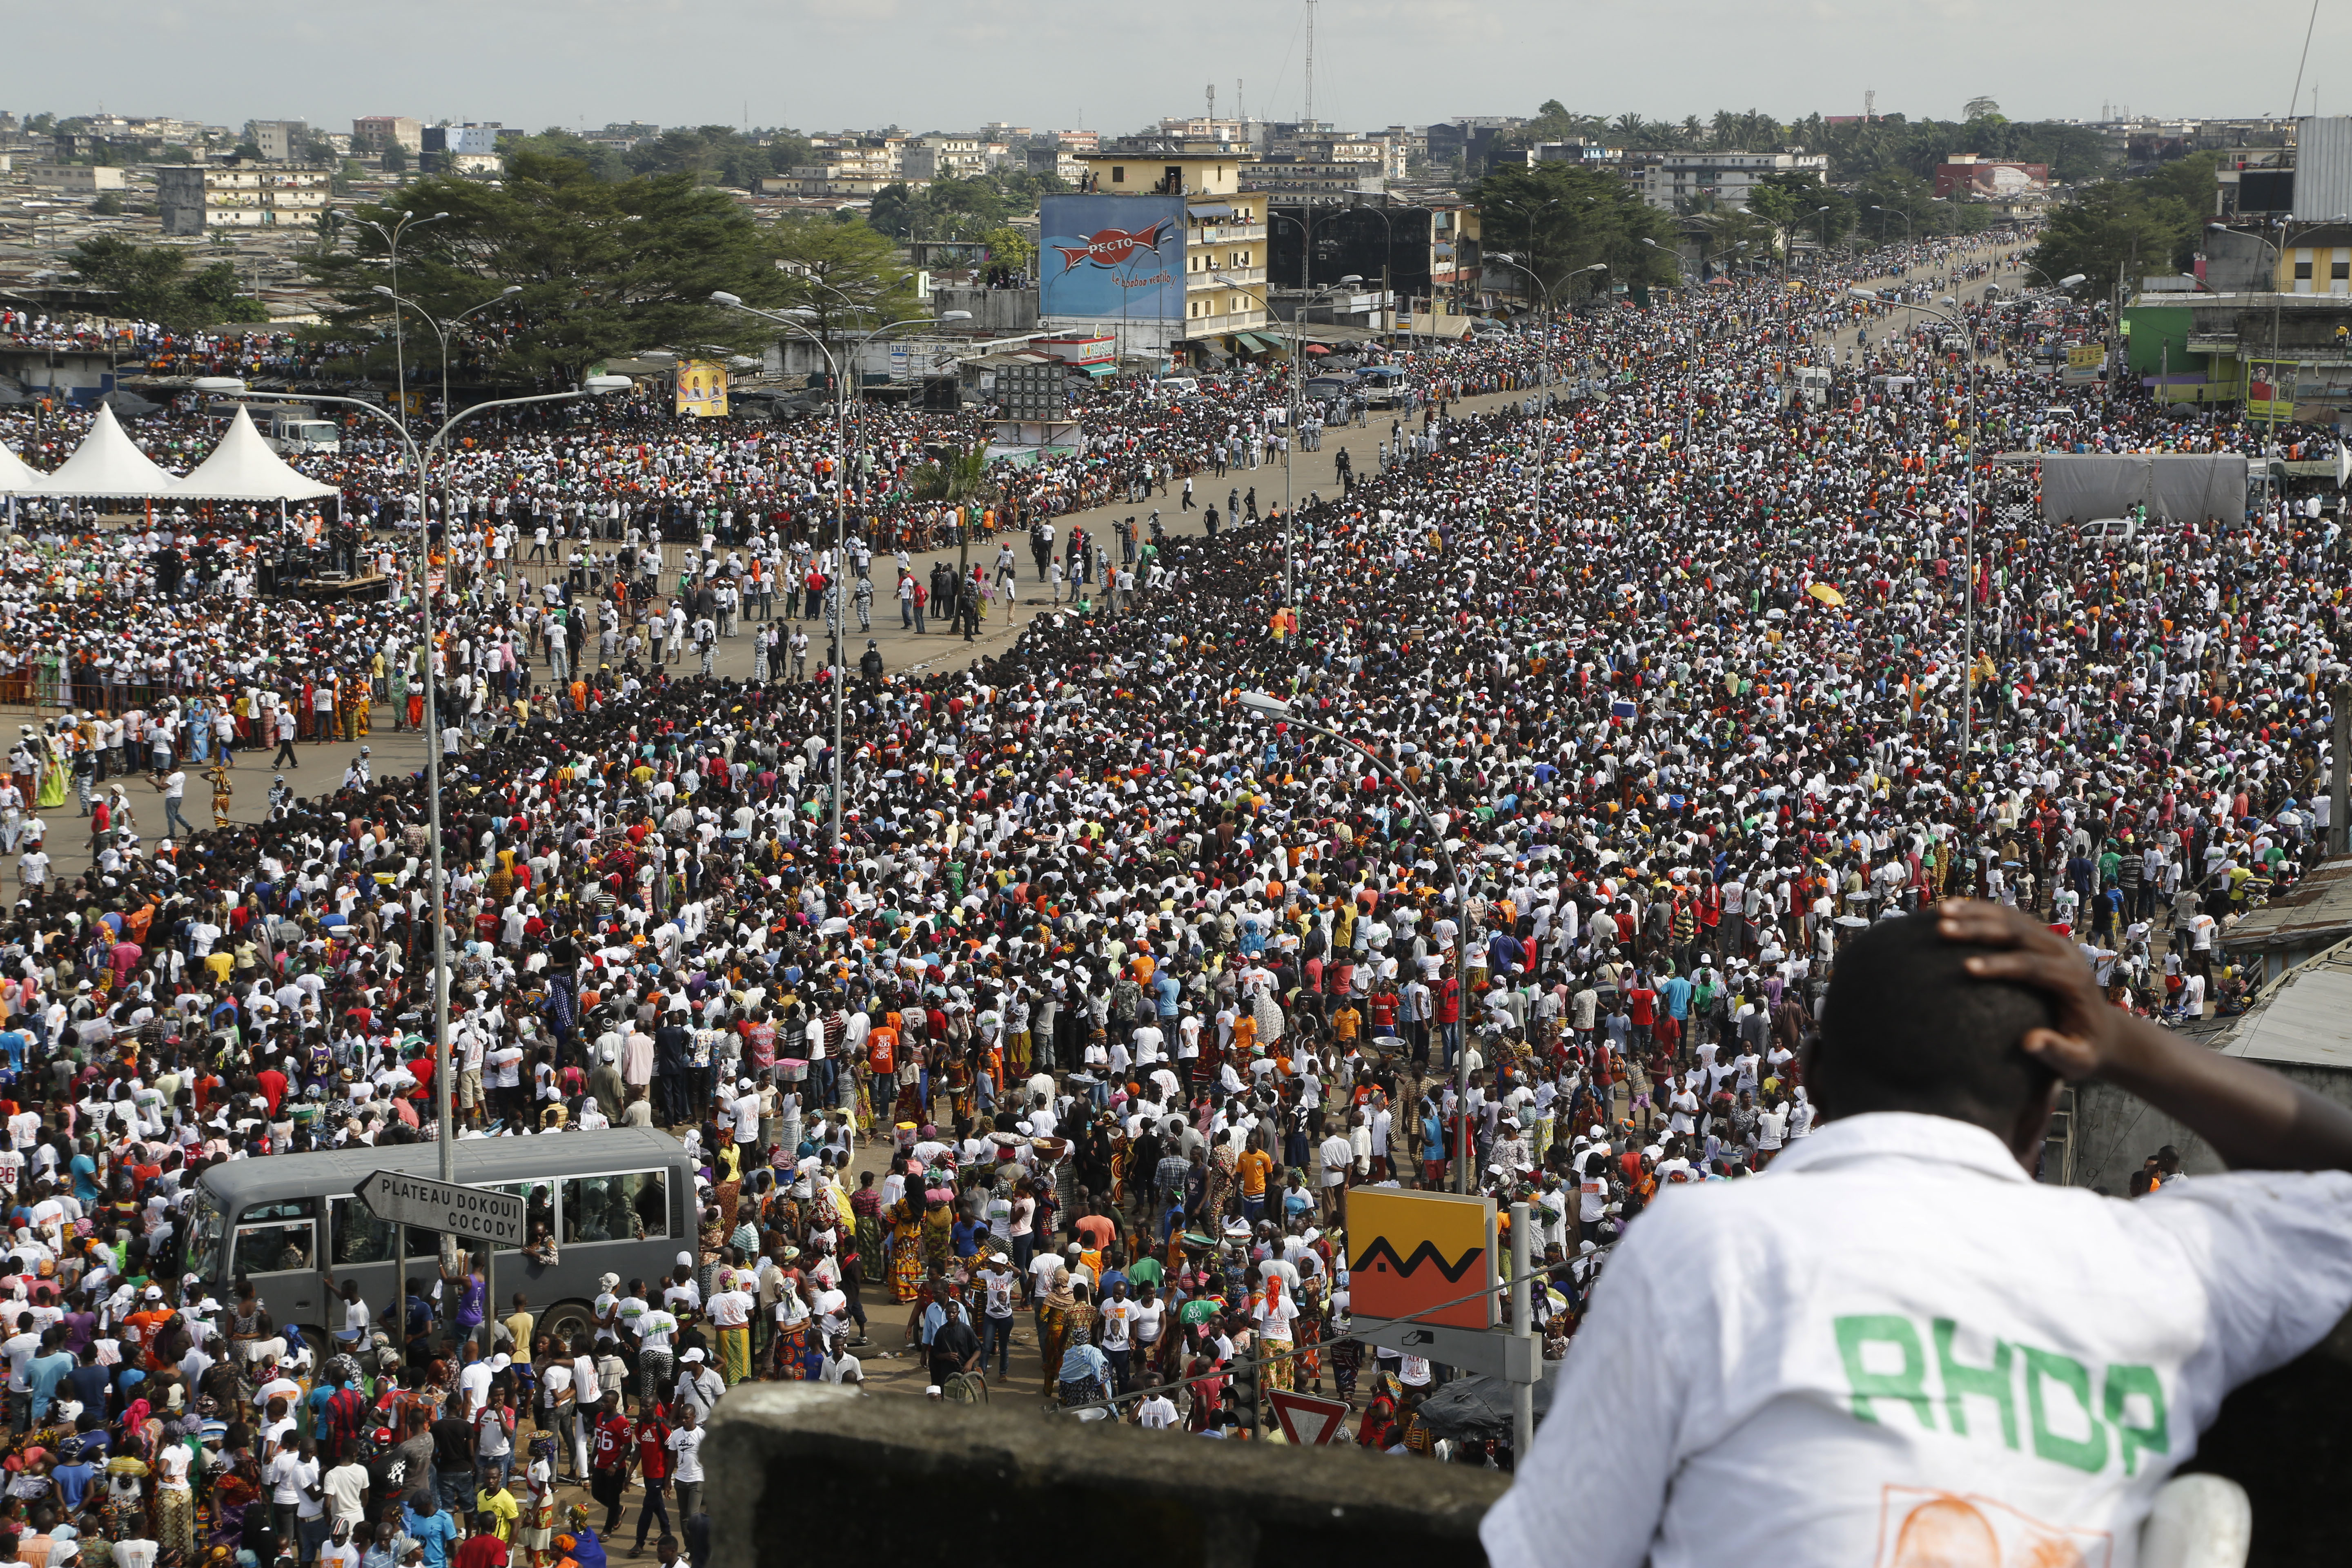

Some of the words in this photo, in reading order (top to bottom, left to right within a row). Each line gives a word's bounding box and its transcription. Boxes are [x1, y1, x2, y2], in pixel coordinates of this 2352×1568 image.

[1089, 238, 1133, 254] PECTO
[1112, 271, 1120, 285] Le
[1121, 273, 1147, 288] bonbon
[1149, 269, 1171, 285] ventilo
[1081, 343, 1099, 356] NORD
[1101, 341, 1114, 354] SUD
[1011, 453, 1028, 462] AVEC
[910, 1017, 919, 1030] 15
[313, 1063, 329, 1077] 34
[98, 1110, 103, 1119] 3
[382, 1178, 450, 1205] PLATEAU
[457, 1194, 517, 1219] DOKOUI
[448, 1212, 516, 1238] COCODY
[988, 1281, 1009, 1291] ADO
[1187, 1311, 1201, 1320] ADO
[1833, 1314, 2170, 1477] RHDP
[595, 1428, 613, 1450] 56
